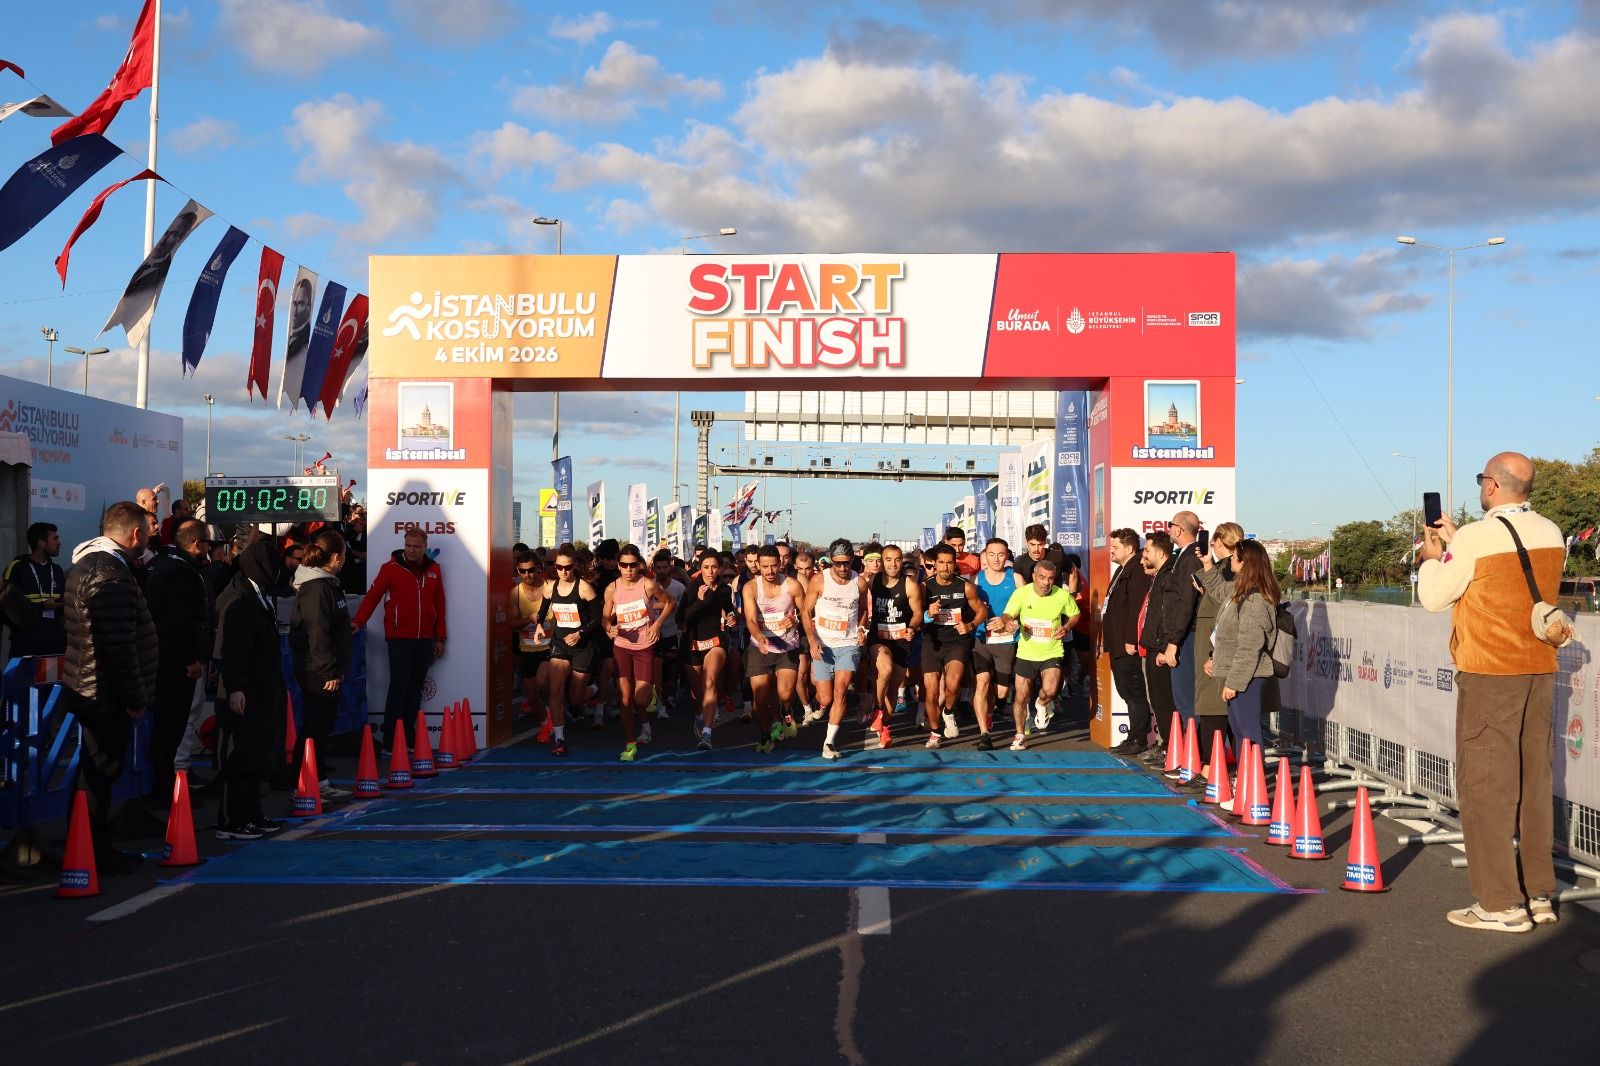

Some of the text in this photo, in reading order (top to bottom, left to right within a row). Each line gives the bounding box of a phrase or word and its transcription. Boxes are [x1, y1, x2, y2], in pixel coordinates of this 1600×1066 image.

[688, 262, 904, 314] START
[433, 291, 596, 317] İSTANBULU
[997, 320, 1051, 331] BURADA
[692, 316, 905, 368] FINISH
[435, 342, 559, 363] 4 EKİM 2026
[385, 448, 466, 461] istanbul
[1132, 445, 1215, 460] istanbul
[386, 489, 466, 506] SPORTIVE
[1133, 487, 1215, 505] SPORTIVE
[1296, 843, 1323, 851] TIMING
